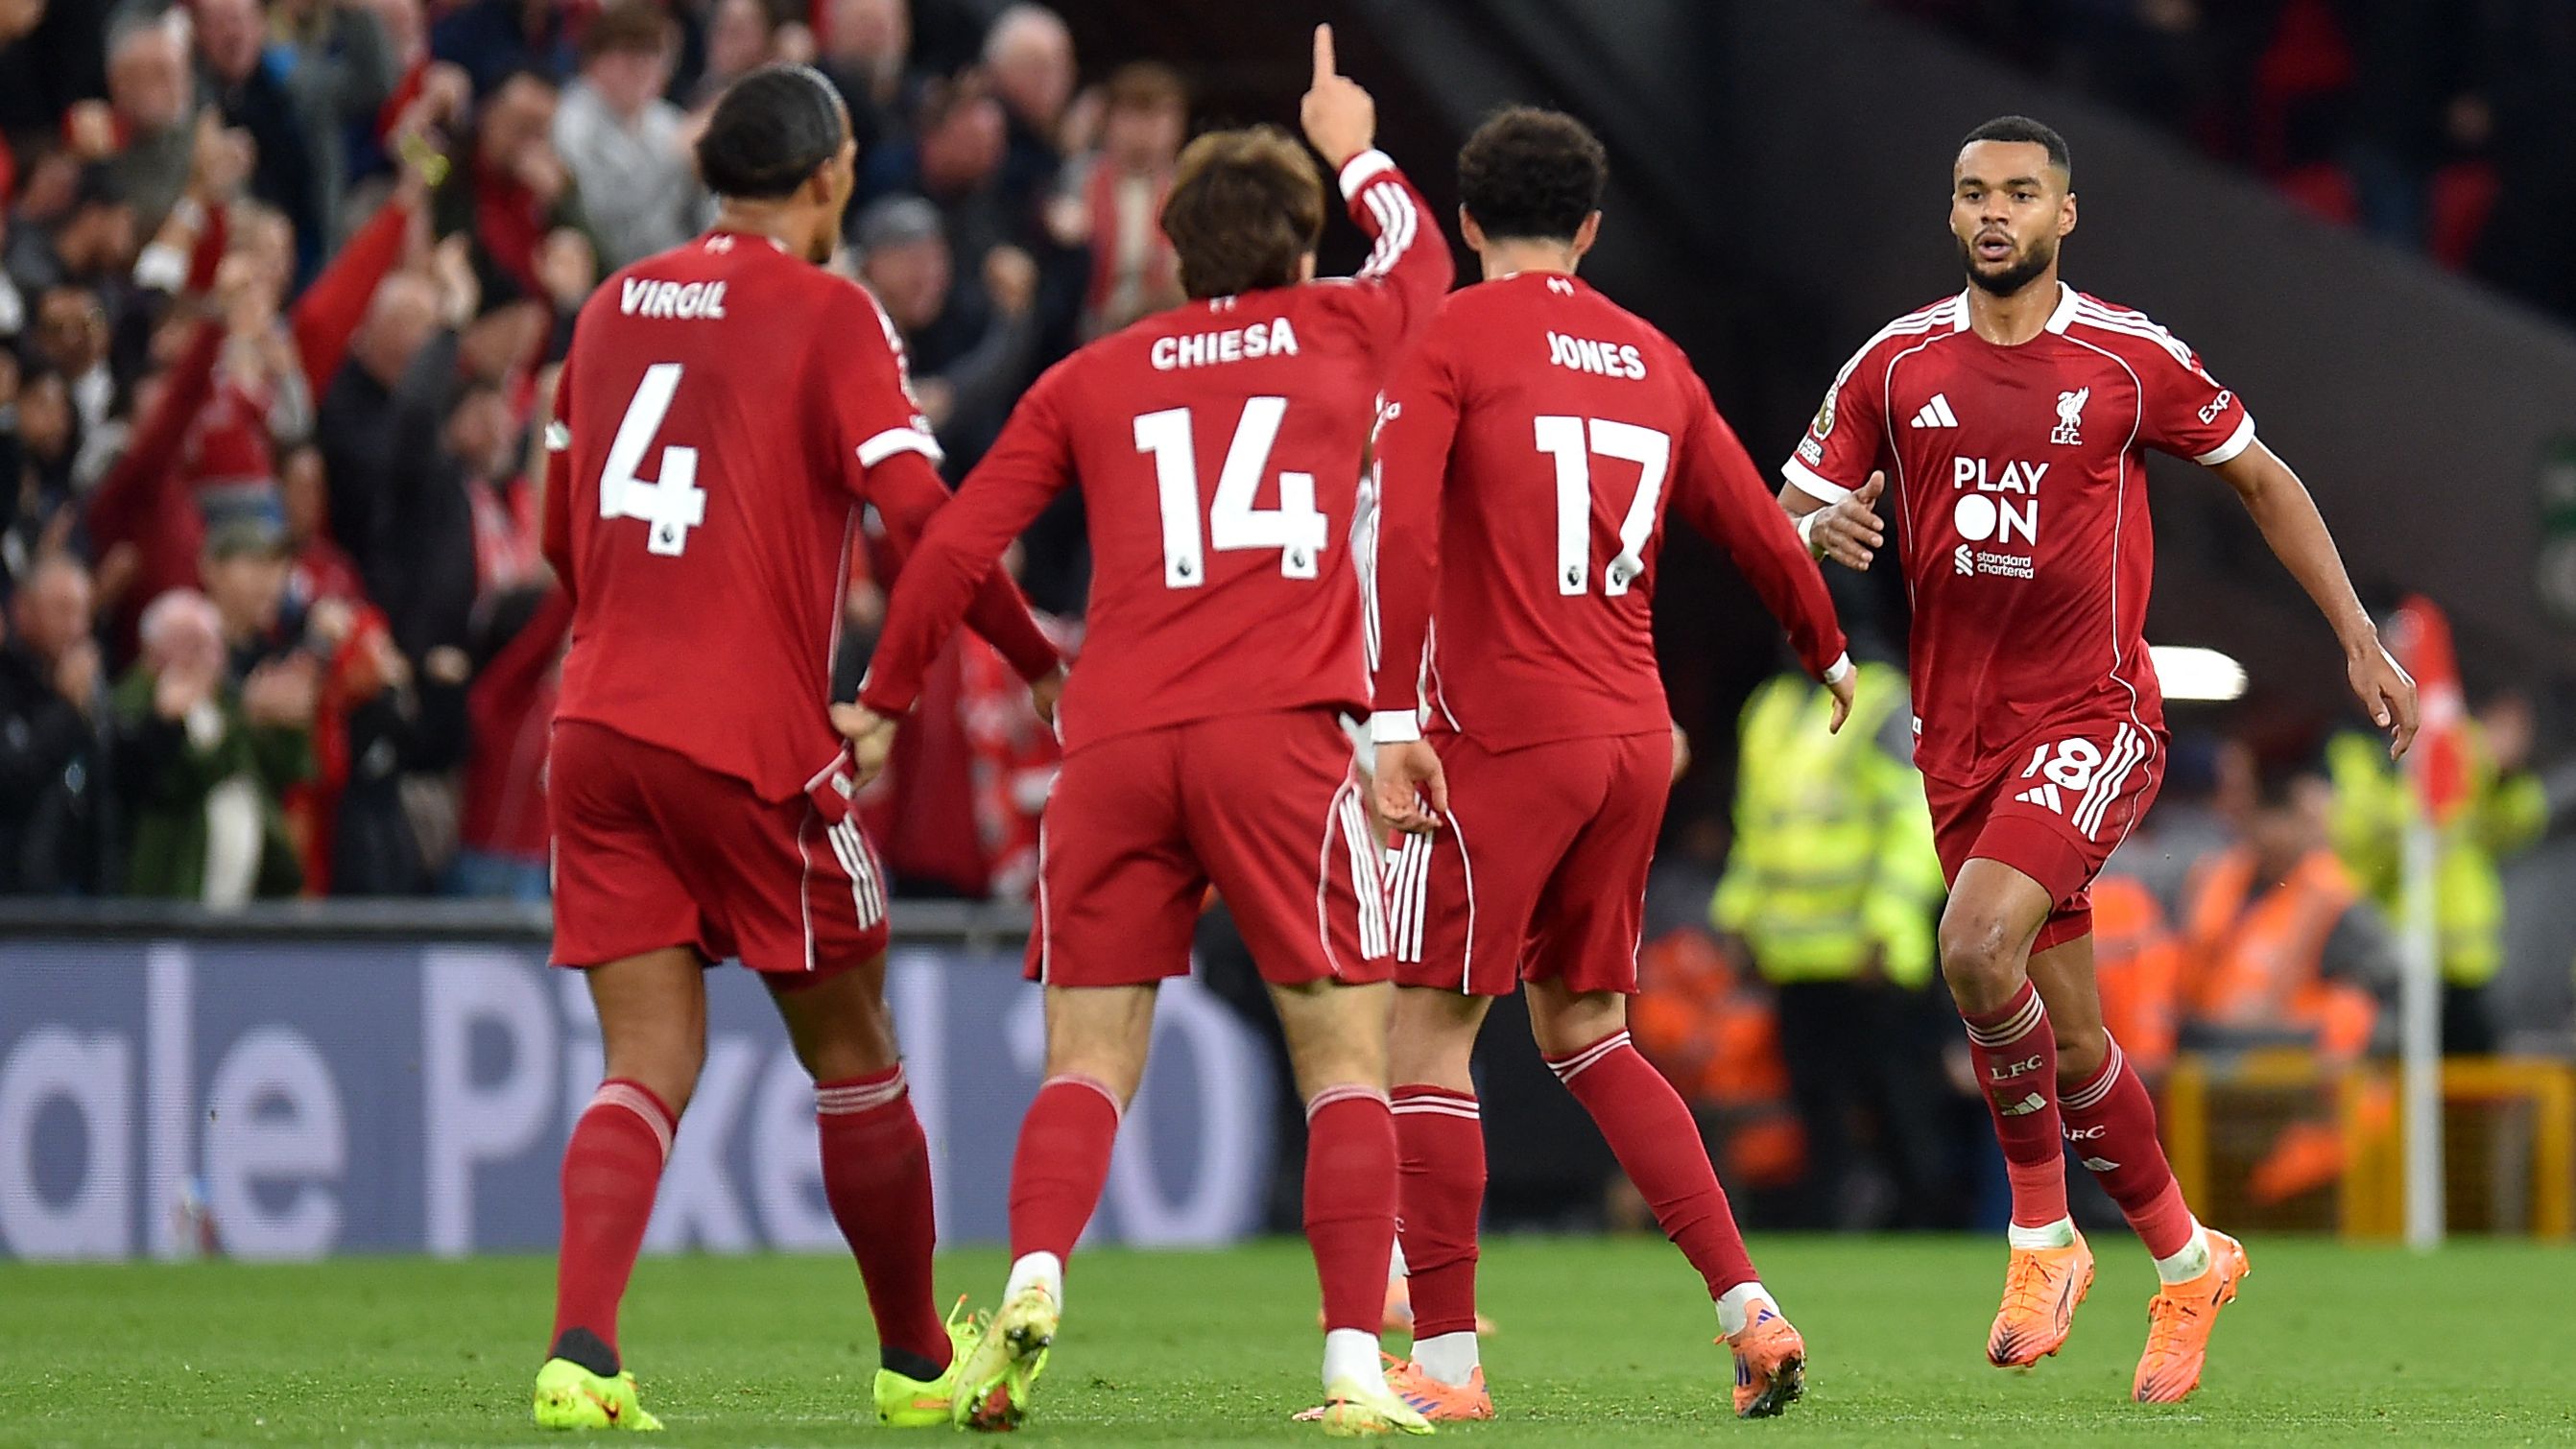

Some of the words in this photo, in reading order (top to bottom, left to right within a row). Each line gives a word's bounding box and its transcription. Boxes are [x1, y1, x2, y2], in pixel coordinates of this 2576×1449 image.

[620, 276, 727, 320] VIRGIL
[1151, 317, 1299, 370] CHIESA
[1546, 330, 1647, 380] JONES
[2198, 389, 2230, 425] Exp
[599, 362, 707, 557] 4
[1954, 456, 2049, 495] PLAY
[1133, 395, 1329, 589] 14
[1533, 415, 1671, 597] 17
[1954, 493, 2039, 547] ON
[1976, 551, 2032, 567] standard
[1977, 563, 2034, 579] chartered
[2019, 737, 2103, 792] 18
[1991, 1055, 2043, 1081] LFC
[1008, 973, 1267, 1249] 0
